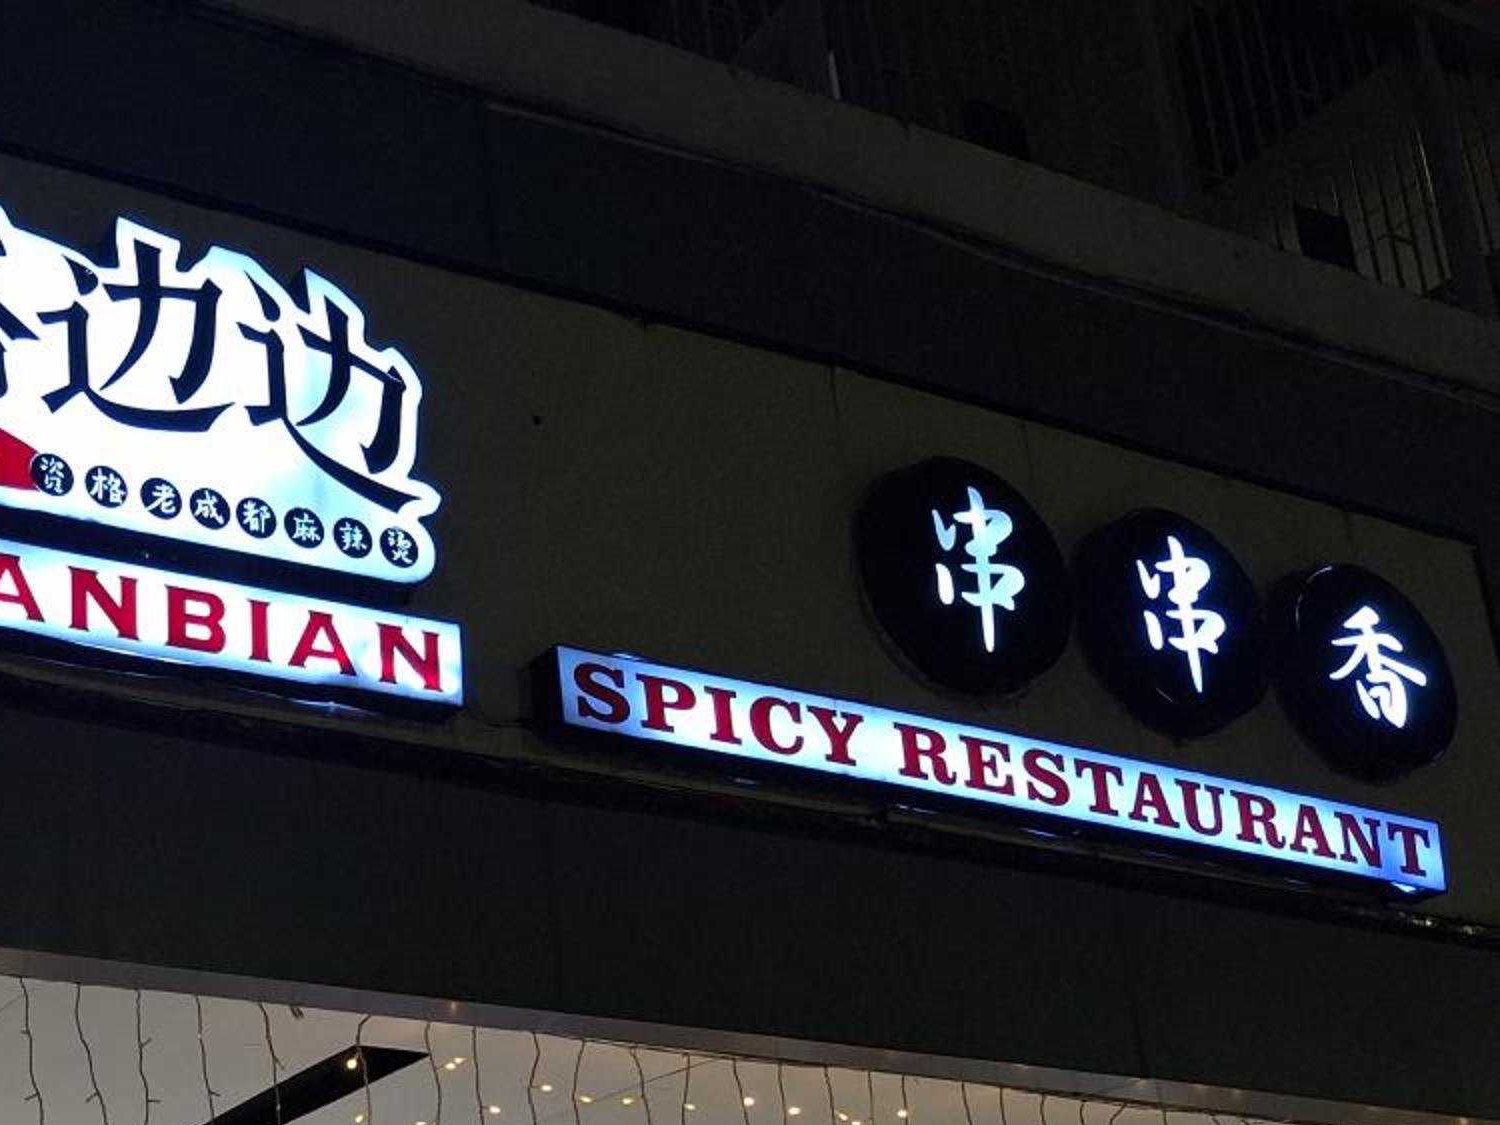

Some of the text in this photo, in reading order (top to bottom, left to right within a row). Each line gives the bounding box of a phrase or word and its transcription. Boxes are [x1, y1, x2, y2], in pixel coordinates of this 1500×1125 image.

[35, 454, 416, 566] 资格老成都麻辣烫
[931, 486, 1427, 730] 串串香
[574, 663, 1433, 879] SPICY RESTAURANT
